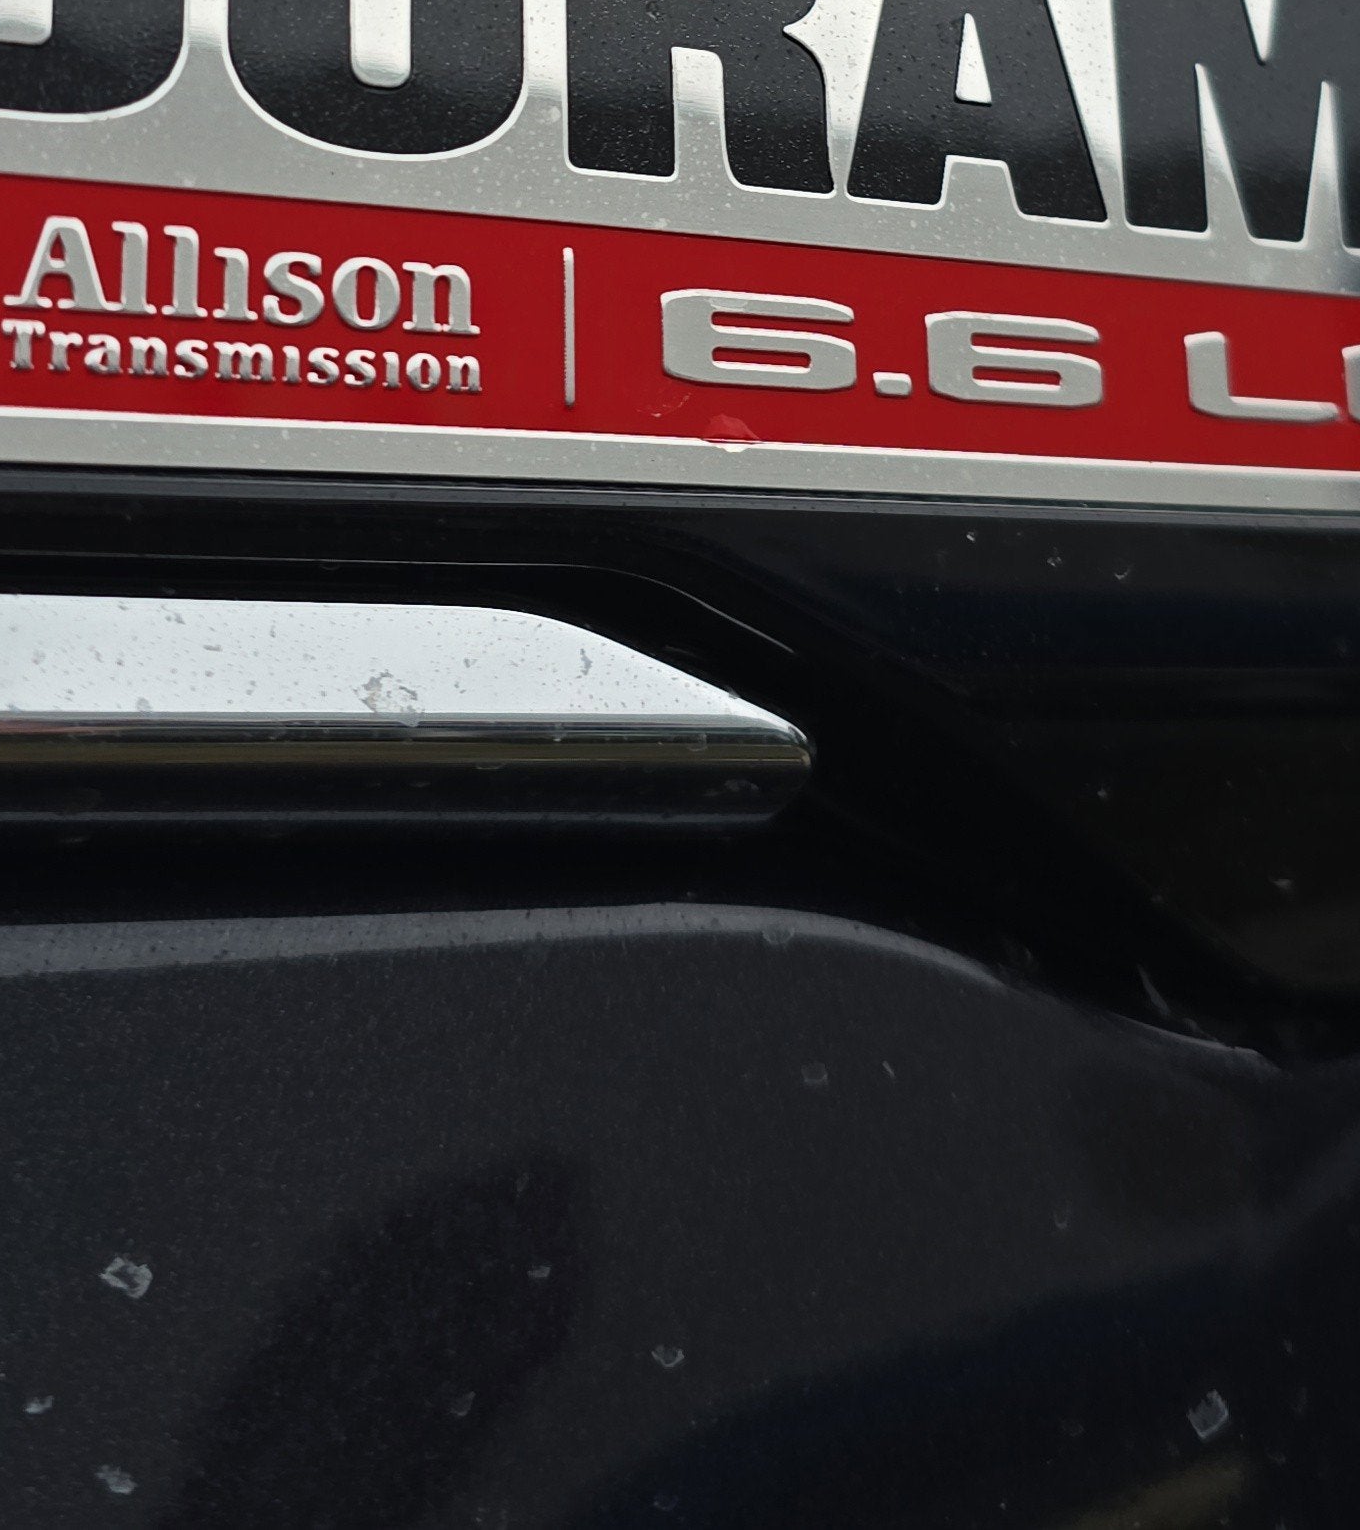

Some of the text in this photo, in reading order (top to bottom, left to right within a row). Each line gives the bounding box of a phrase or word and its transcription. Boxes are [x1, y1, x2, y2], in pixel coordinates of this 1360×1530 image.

[4, 214, 481, 338] Allison
[1, 319, 483, 394] Transmission
[660, 287, 1104, 410] 6.6
